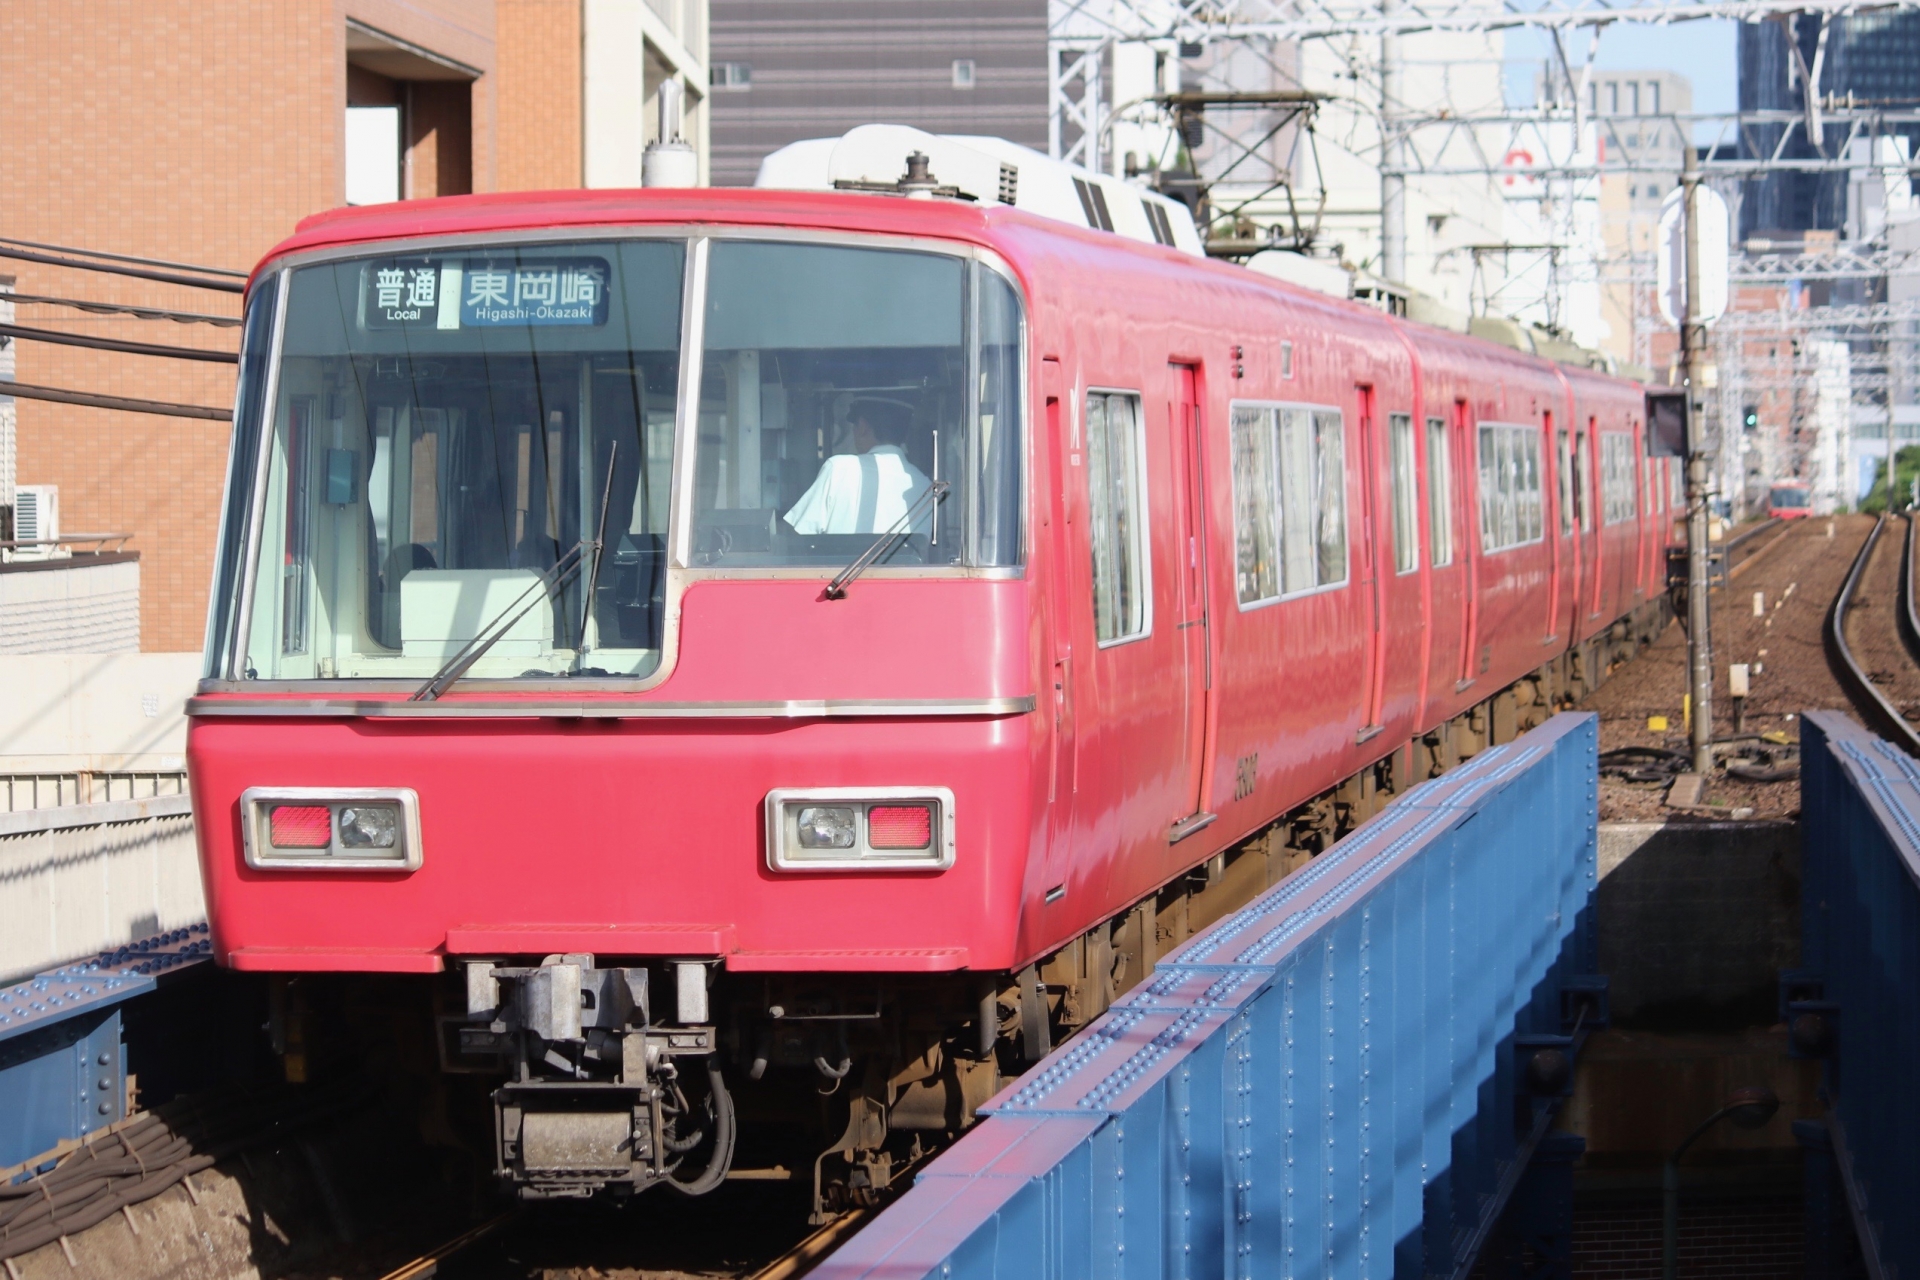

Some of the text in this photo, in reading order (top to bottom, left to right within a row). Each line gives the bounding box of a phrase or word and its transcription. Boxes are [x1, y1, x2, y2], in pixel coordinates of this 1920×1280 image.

[376, 267, 436, 309] 普通
[466, 264, 604, 306] 東岡崎
[386, 308, 421, 321] Local
[475, 306, 592, 323] Higashi-Okazaki
